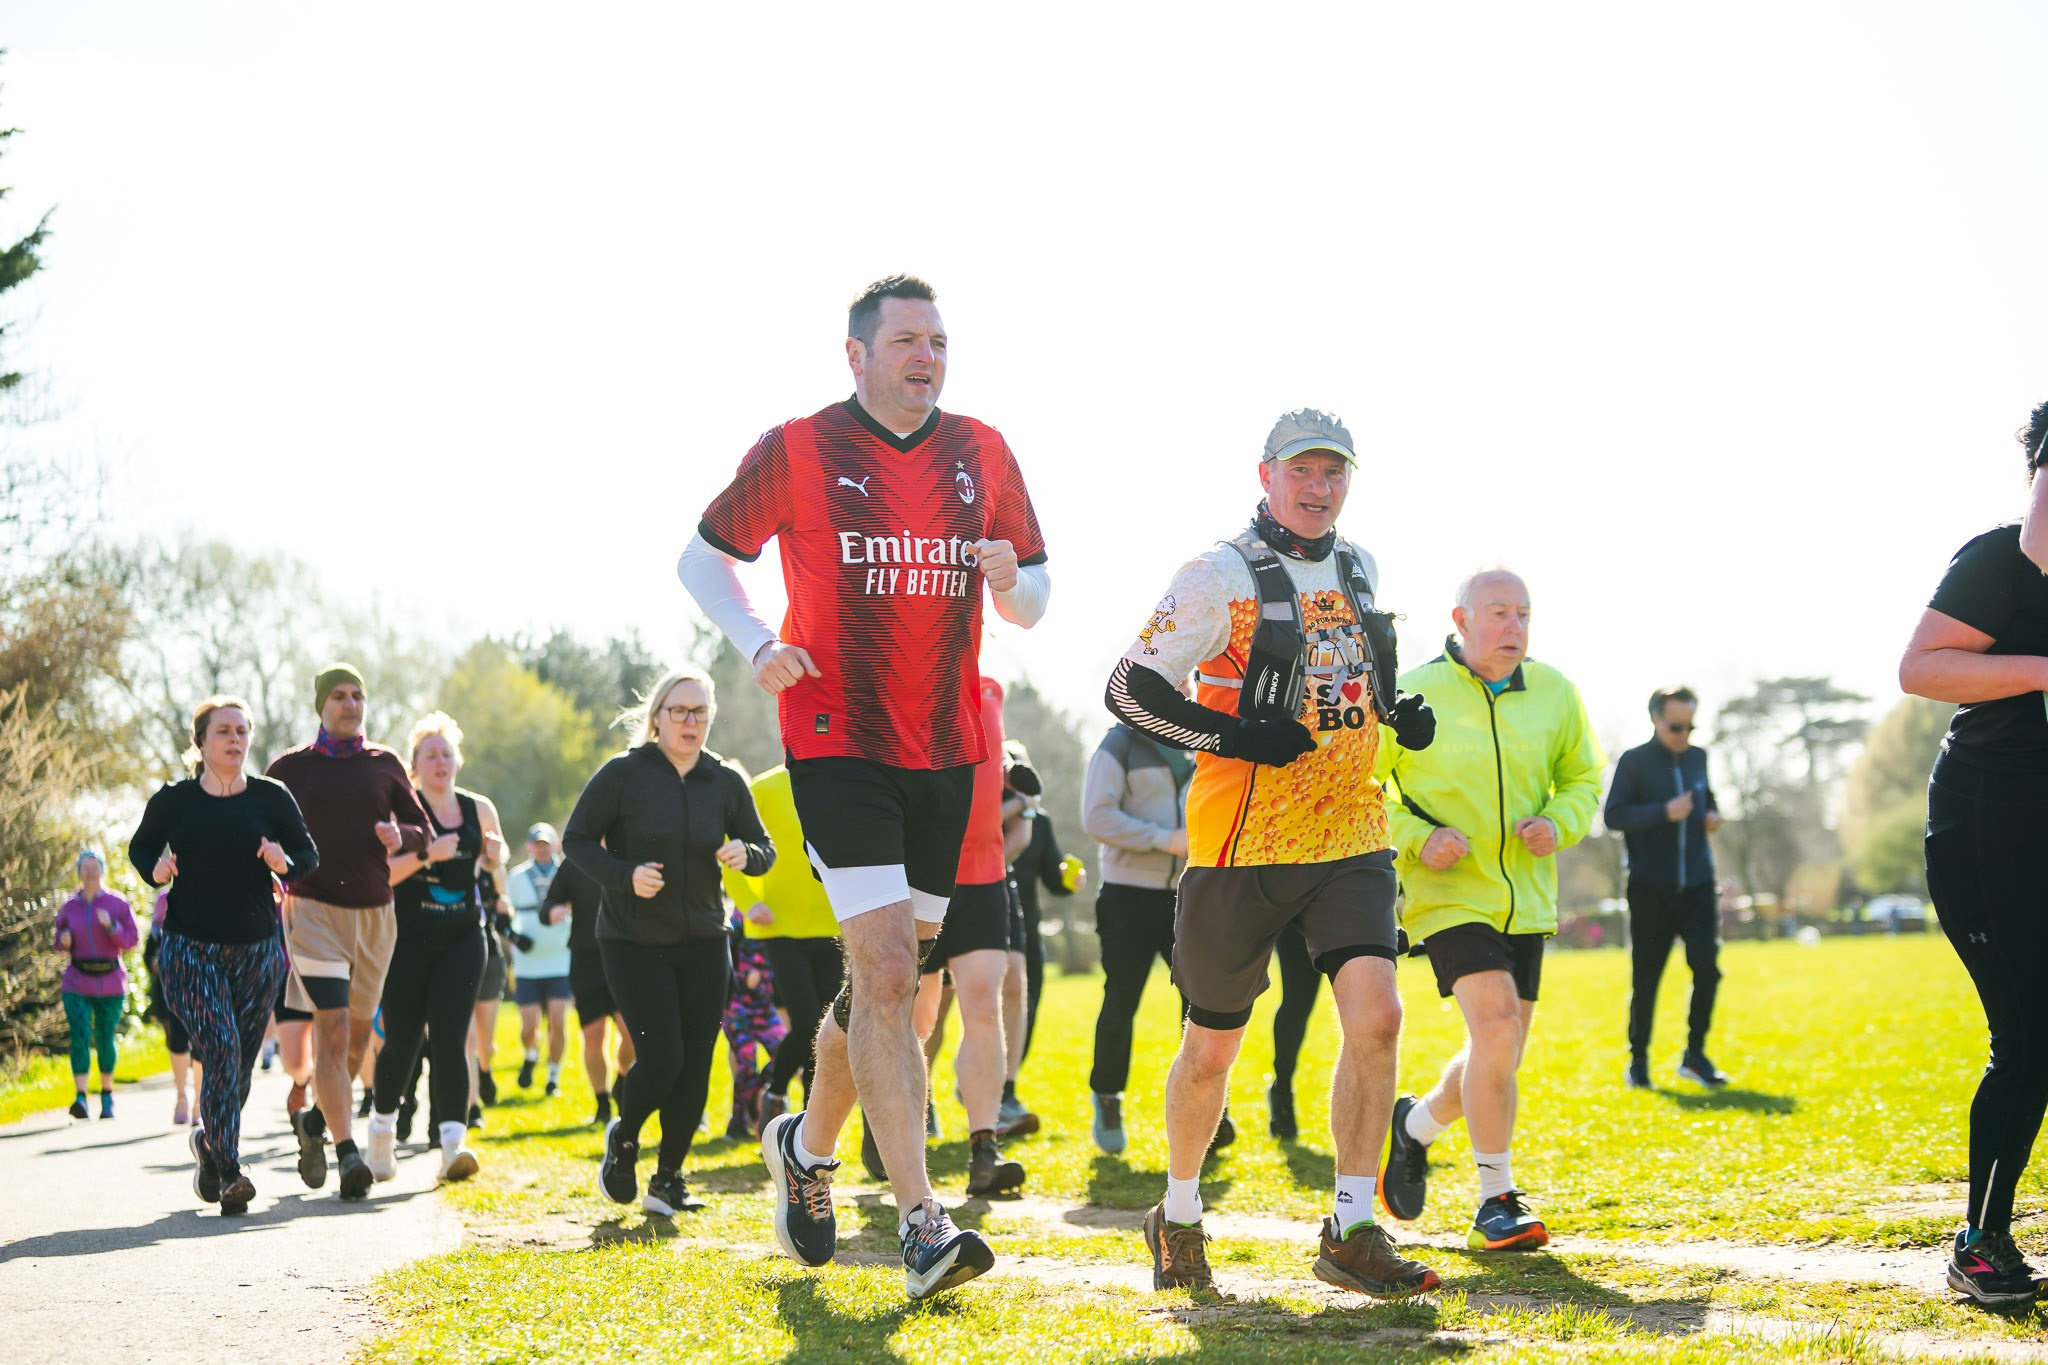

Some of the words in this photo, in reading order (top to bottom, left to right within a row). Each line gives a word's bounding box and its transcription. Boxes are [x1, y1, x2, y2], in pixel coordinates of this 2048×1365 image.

[865, 568, 900, 595] FLY
[906, 568, 968, 597] BETTER
[1266, 671, 1280, 705] AONIJIE
[1316, 706, 1365, 731] BO
